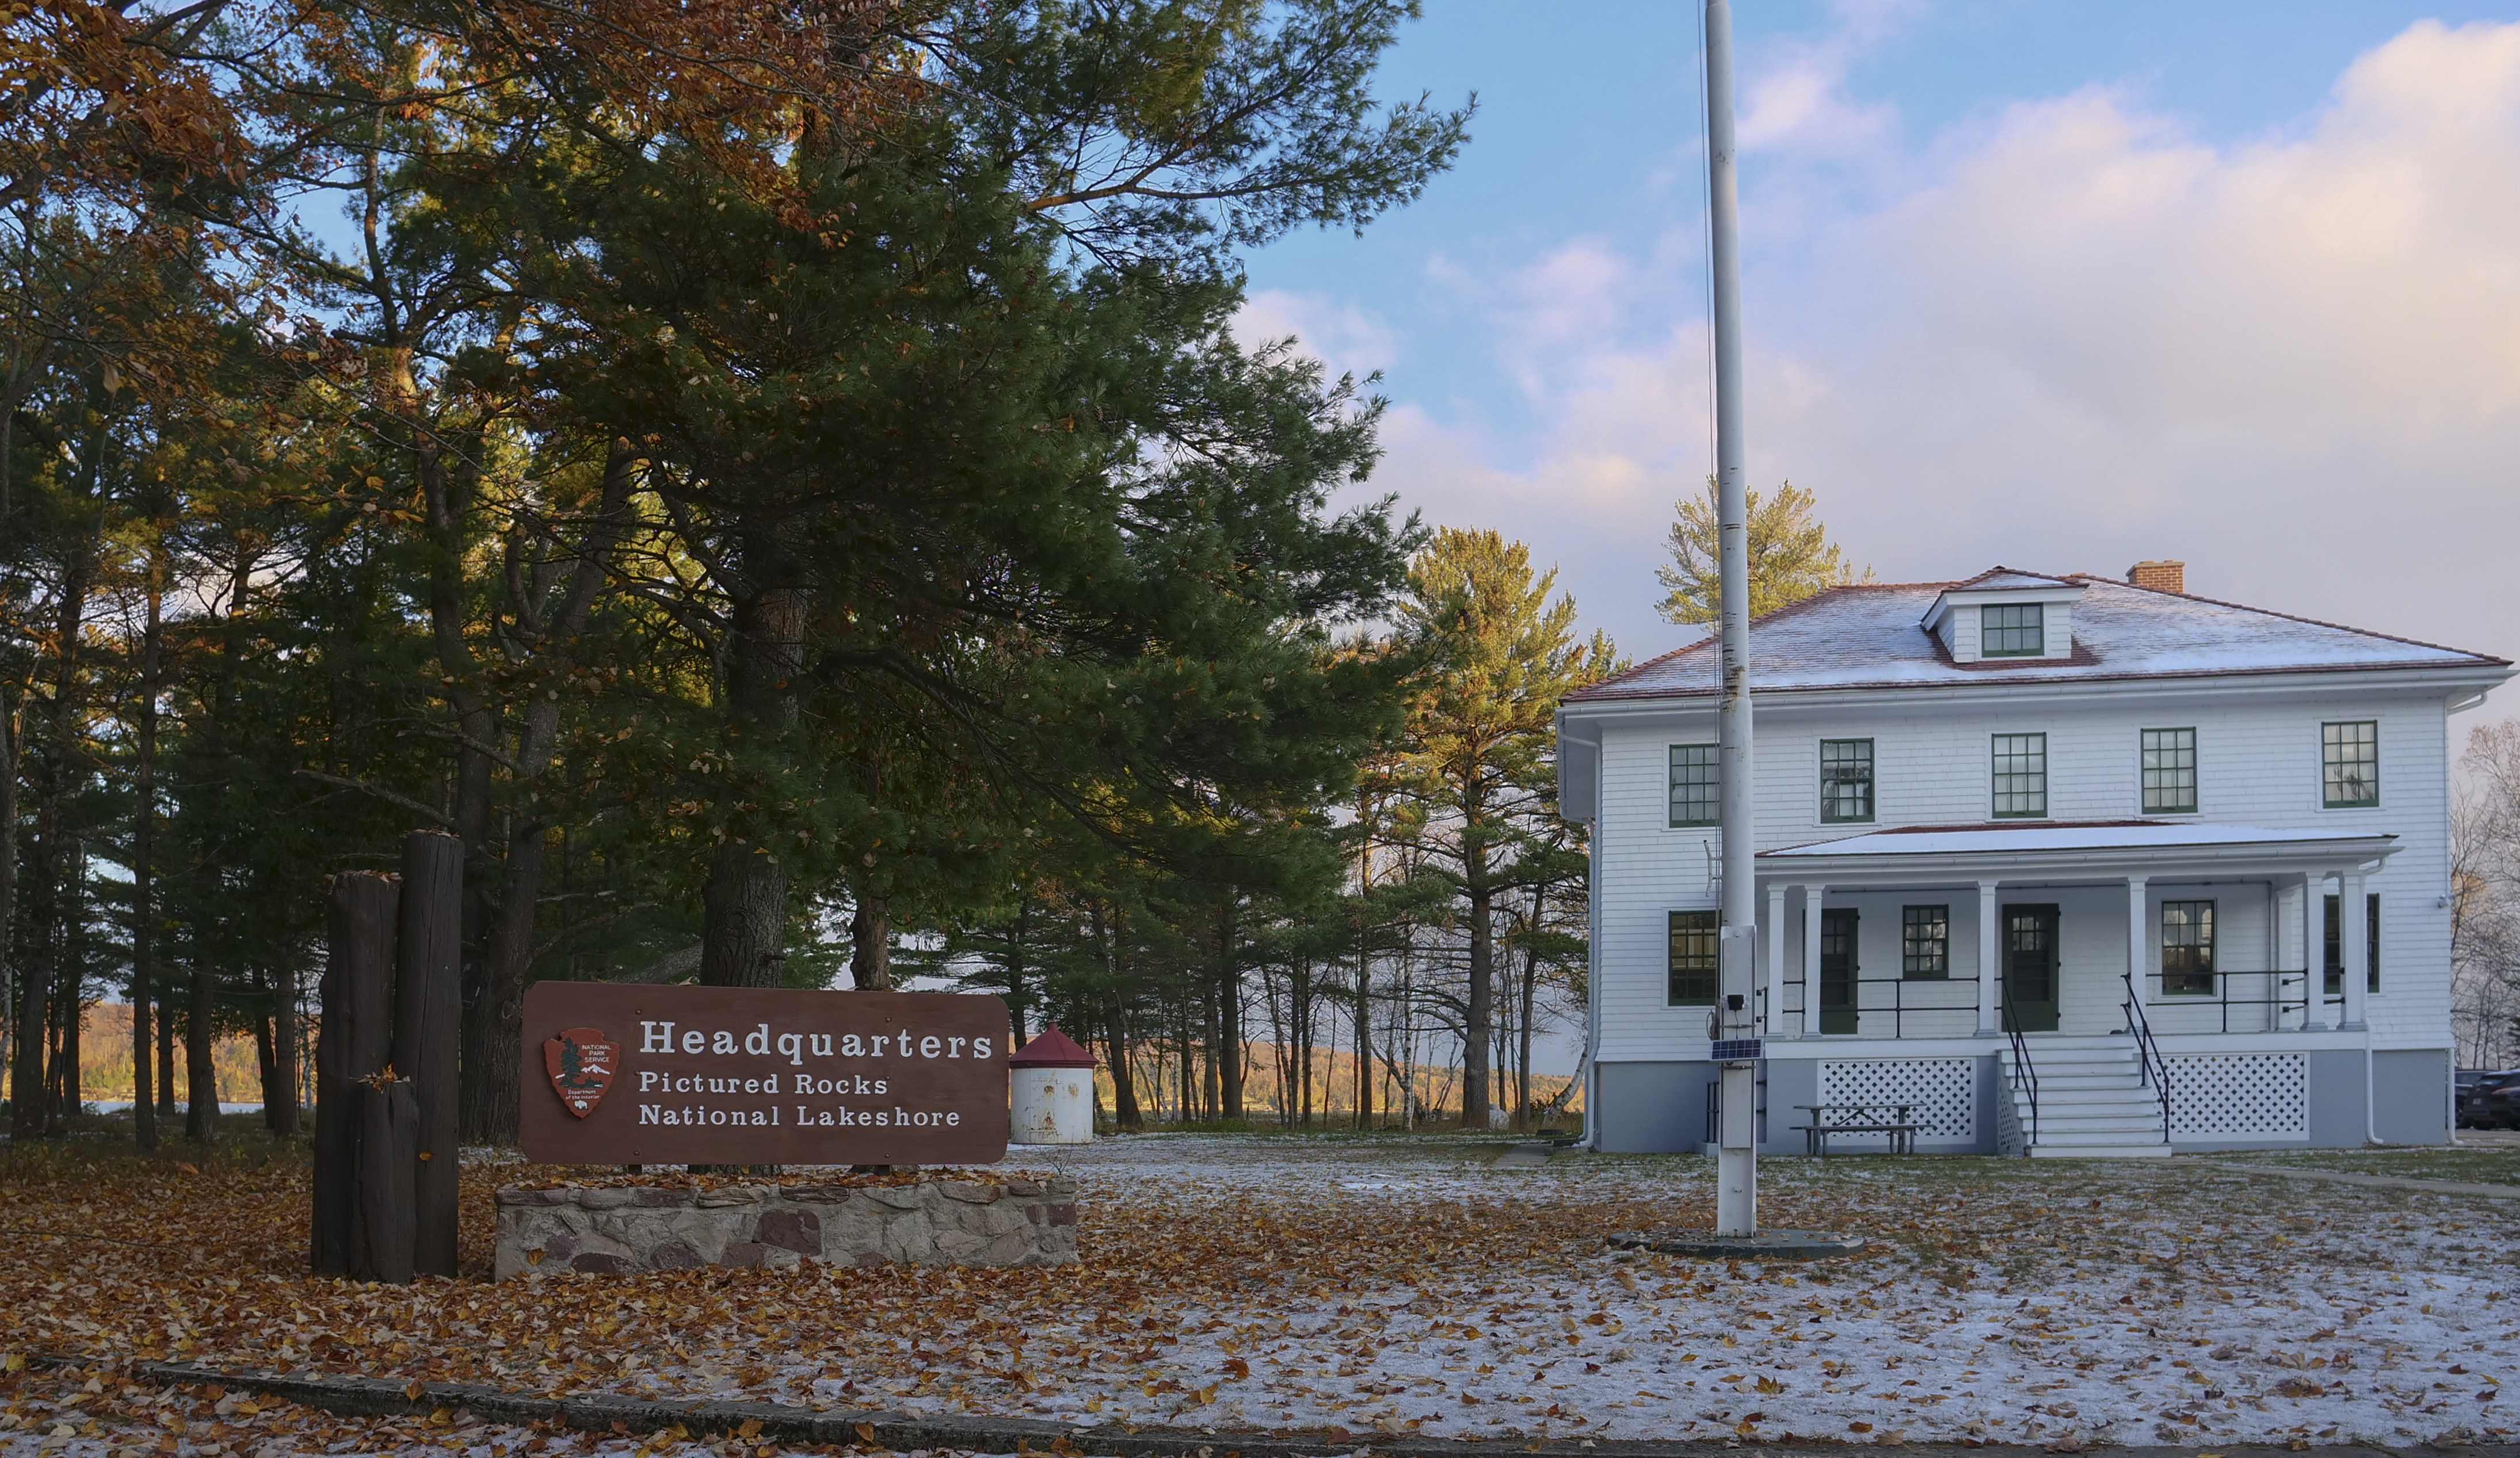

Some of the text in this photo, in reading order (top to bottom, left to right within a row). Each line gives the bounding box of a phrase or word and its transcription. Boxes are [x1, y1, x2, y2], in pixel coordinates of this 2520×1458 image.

[639, 1021, 992, 1065] Headquarters
[639, 1071, 889, 1095] Pictured Rocks
[639, 1104, 960, 1126] National Lakeshore
